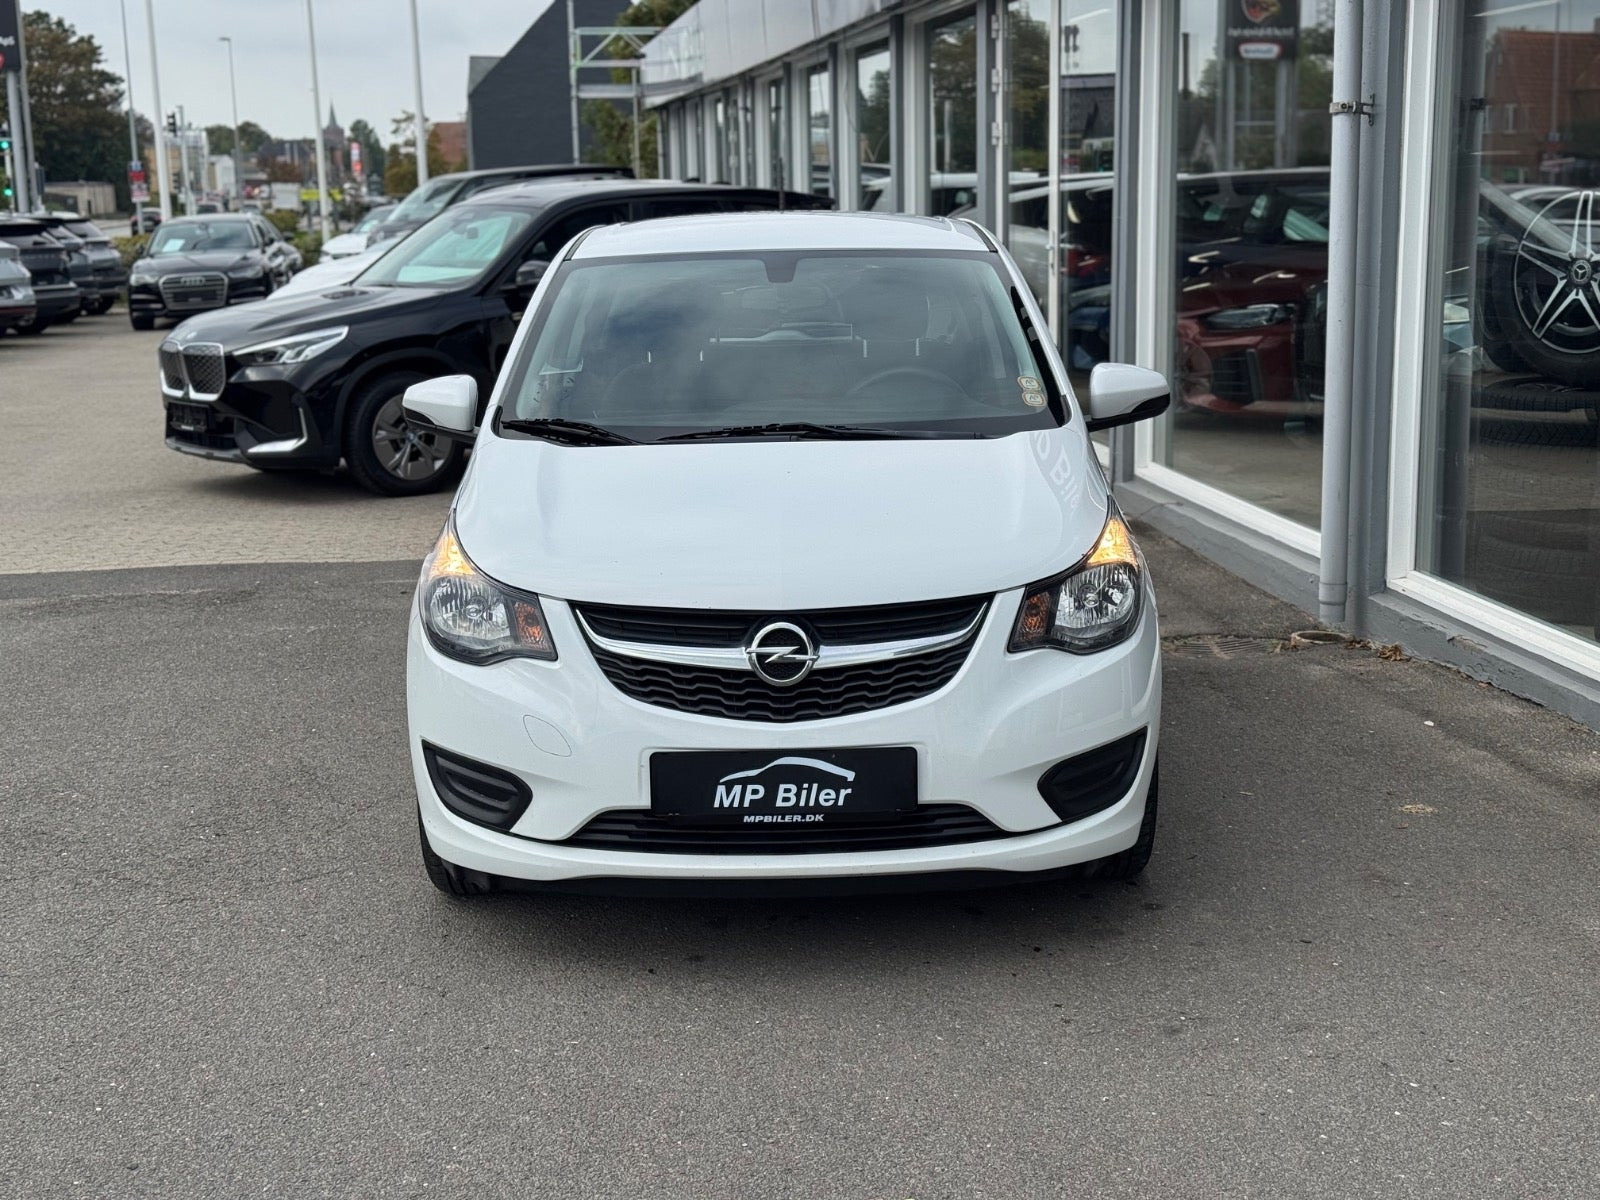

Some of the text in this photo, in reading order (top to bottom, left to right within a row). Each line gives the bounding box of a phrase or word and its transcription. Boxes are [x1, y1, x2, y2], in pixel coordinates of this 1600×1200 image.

[713, 783, 852, 808] MP Biler
[743, 813, 825, 823] MPBILER.DK
